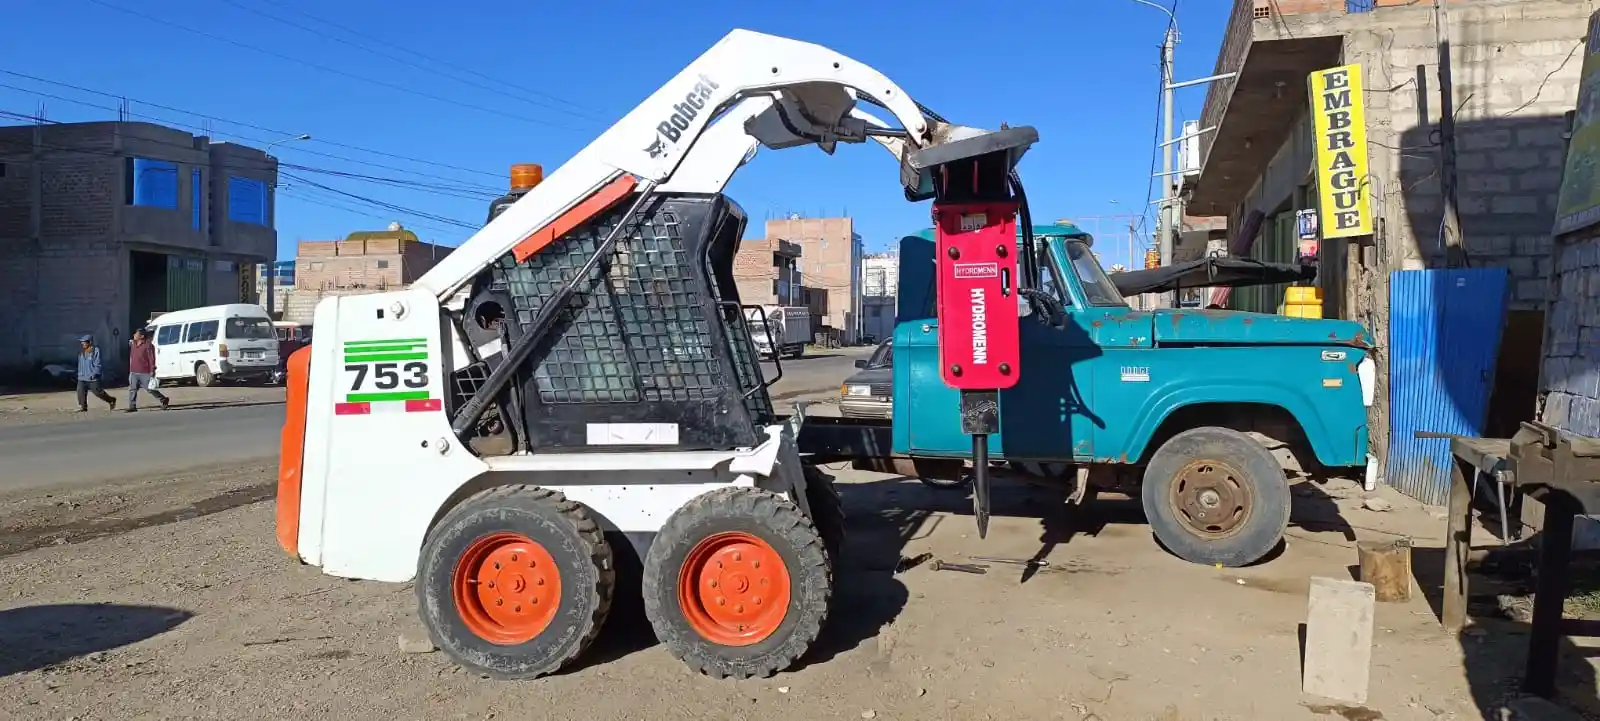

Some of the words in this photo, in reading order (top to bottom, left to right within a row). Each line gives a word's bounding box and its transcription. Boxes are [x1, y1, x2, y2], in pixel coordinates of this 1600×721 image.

[656, 74, 719, 144] Bobcat
[1322, 70, 1360, 230] EMBRAGUE
[955, 266, 997, 275] HYDROMENN
[971, 288, 987, 365] HYDROMENN
[345, 361, 429, 391] 753
